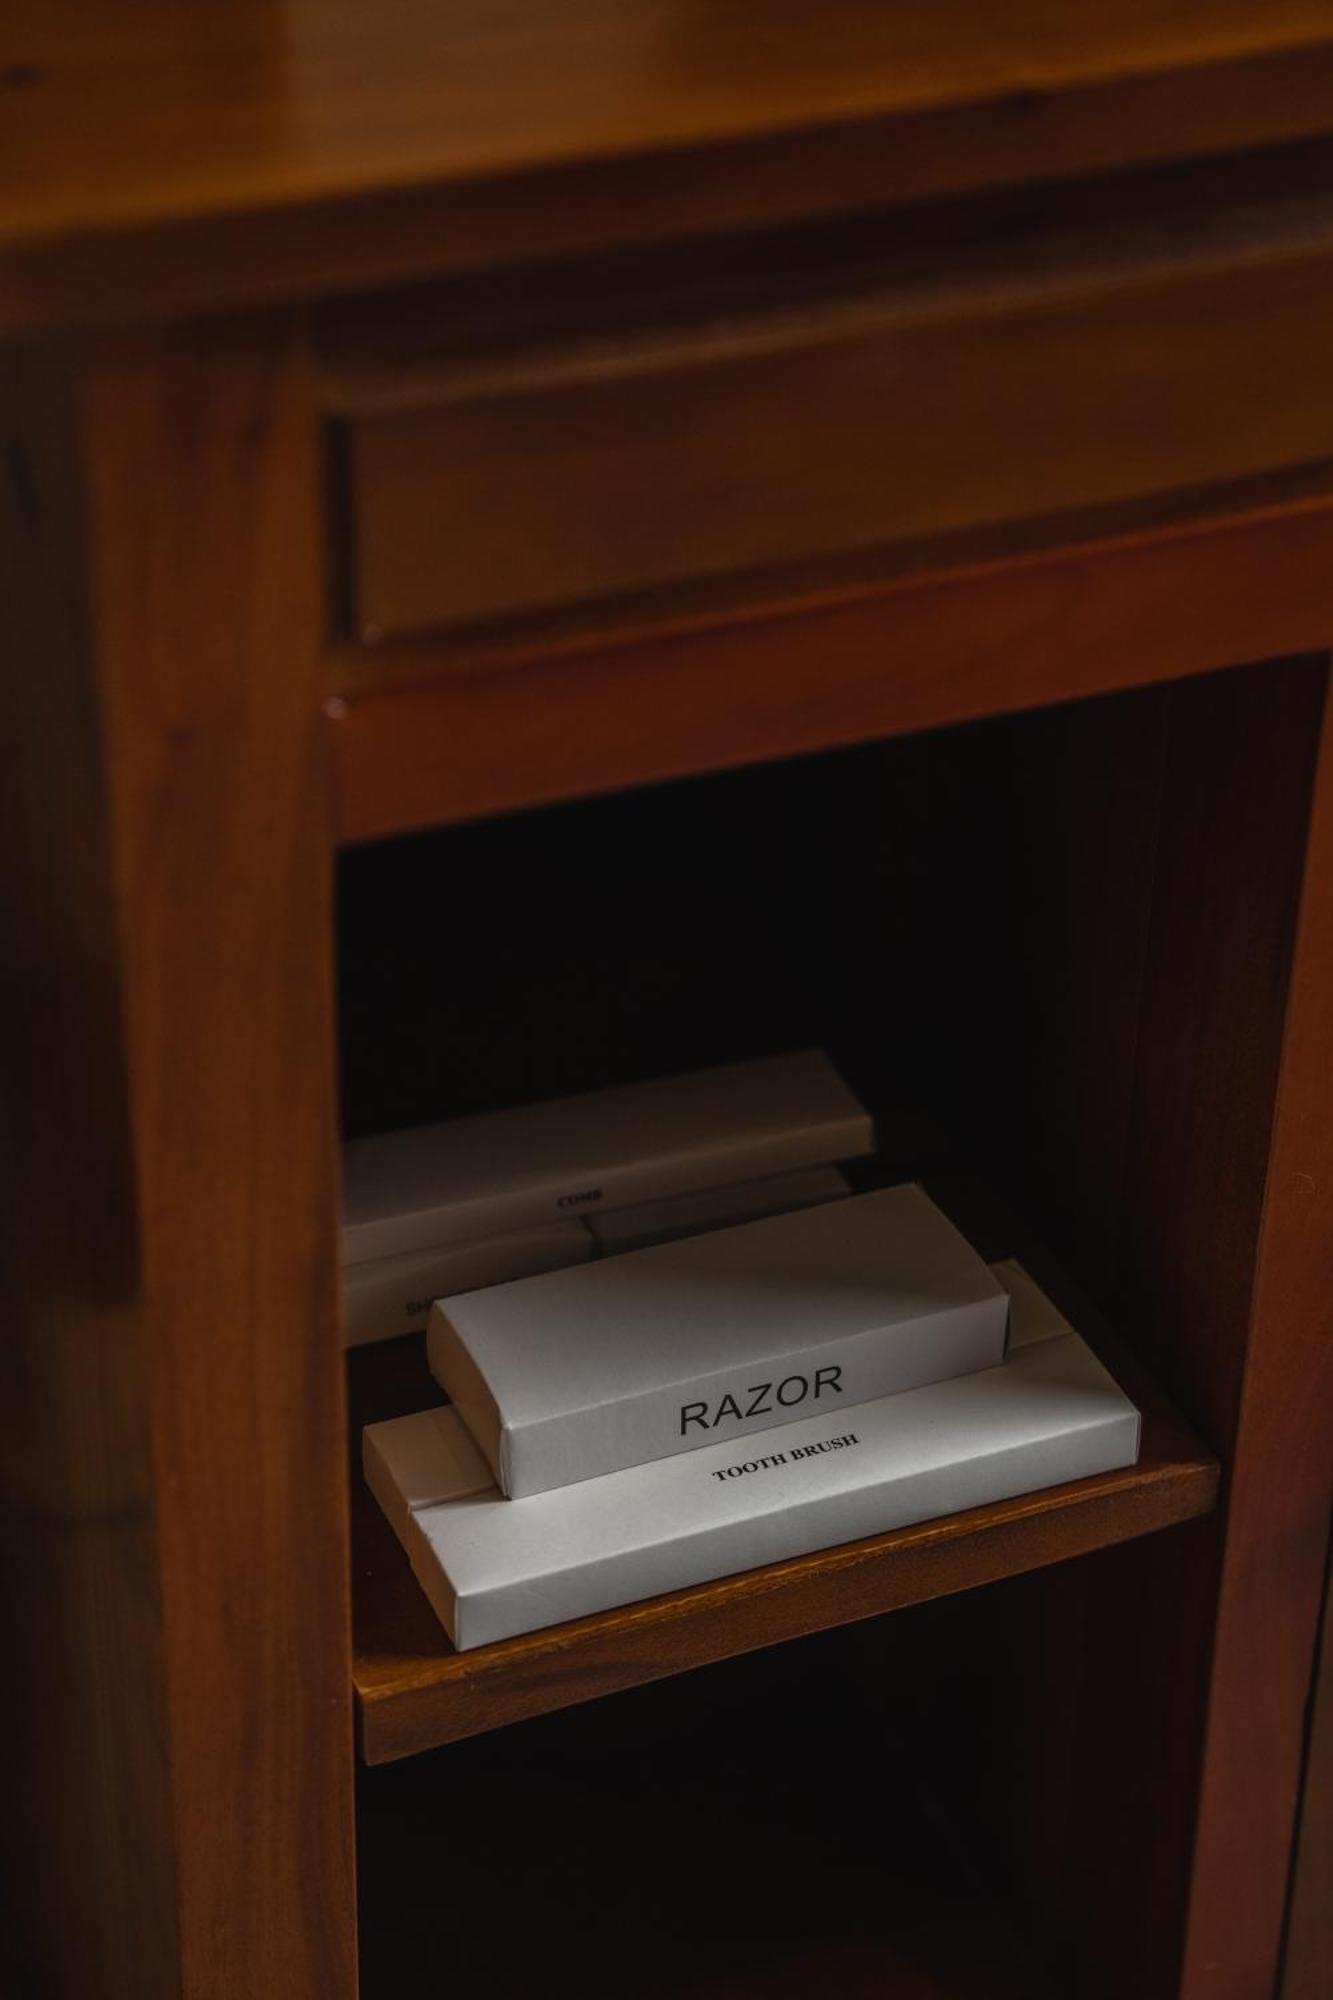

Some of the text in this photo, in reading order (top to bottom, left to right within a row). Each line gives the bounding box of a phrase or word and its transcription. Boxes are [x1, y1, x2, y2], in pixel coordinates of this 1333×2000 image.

[680, 1365, 843, 1436] RAZOR
[712, 1433, 859, 1482] TOOTH BRUSH
